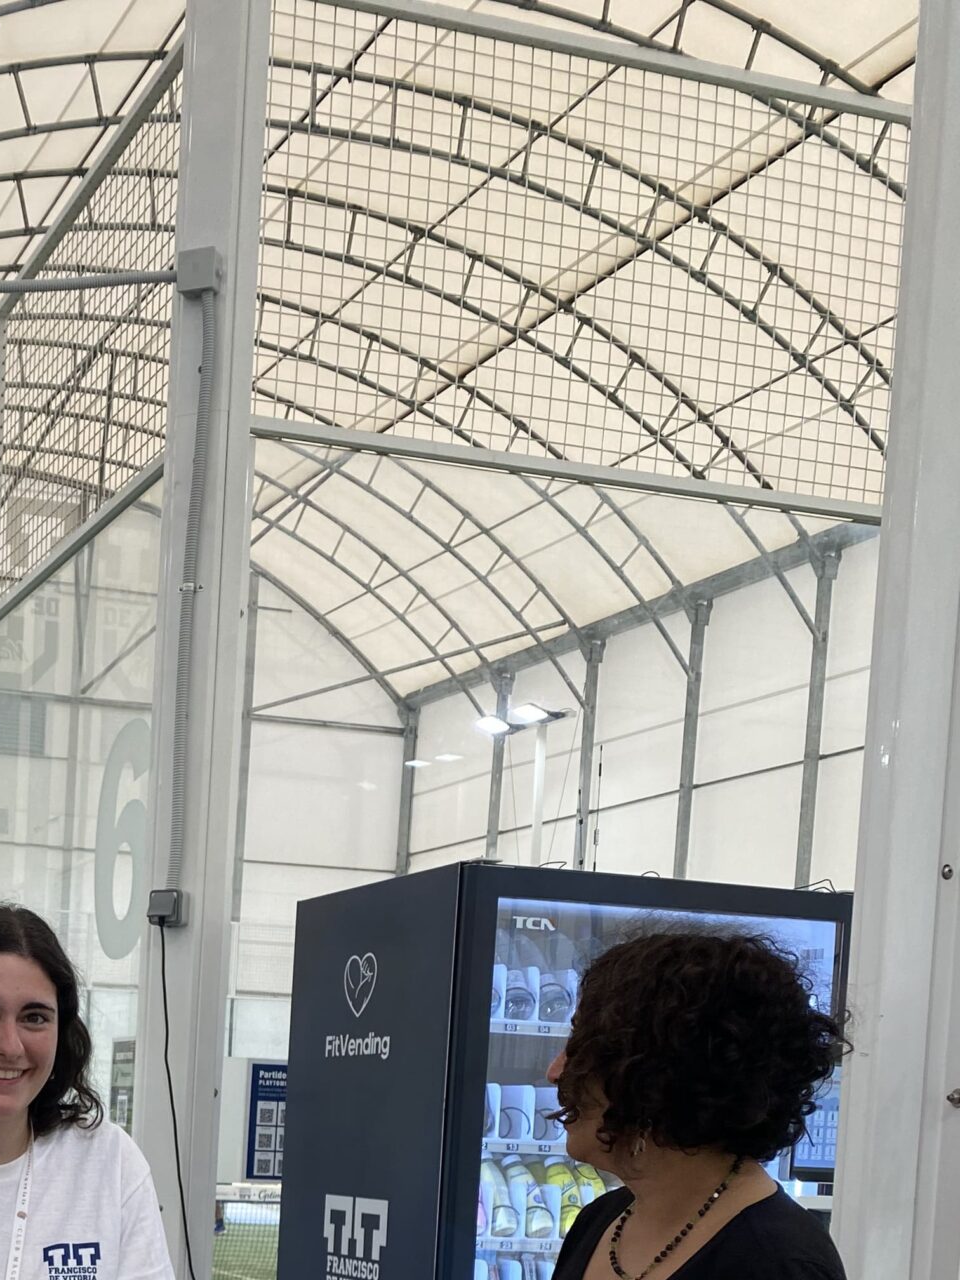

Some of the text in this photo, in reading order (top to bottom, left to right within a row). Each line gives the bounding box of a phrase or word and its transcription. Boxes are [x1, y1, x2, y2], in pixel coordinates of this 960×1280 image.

[512, 915, 556, 931] TCN
[324, 1032, 390, 1060] FitVending
[48, 1266, 97, 1275] FRANCISCO
